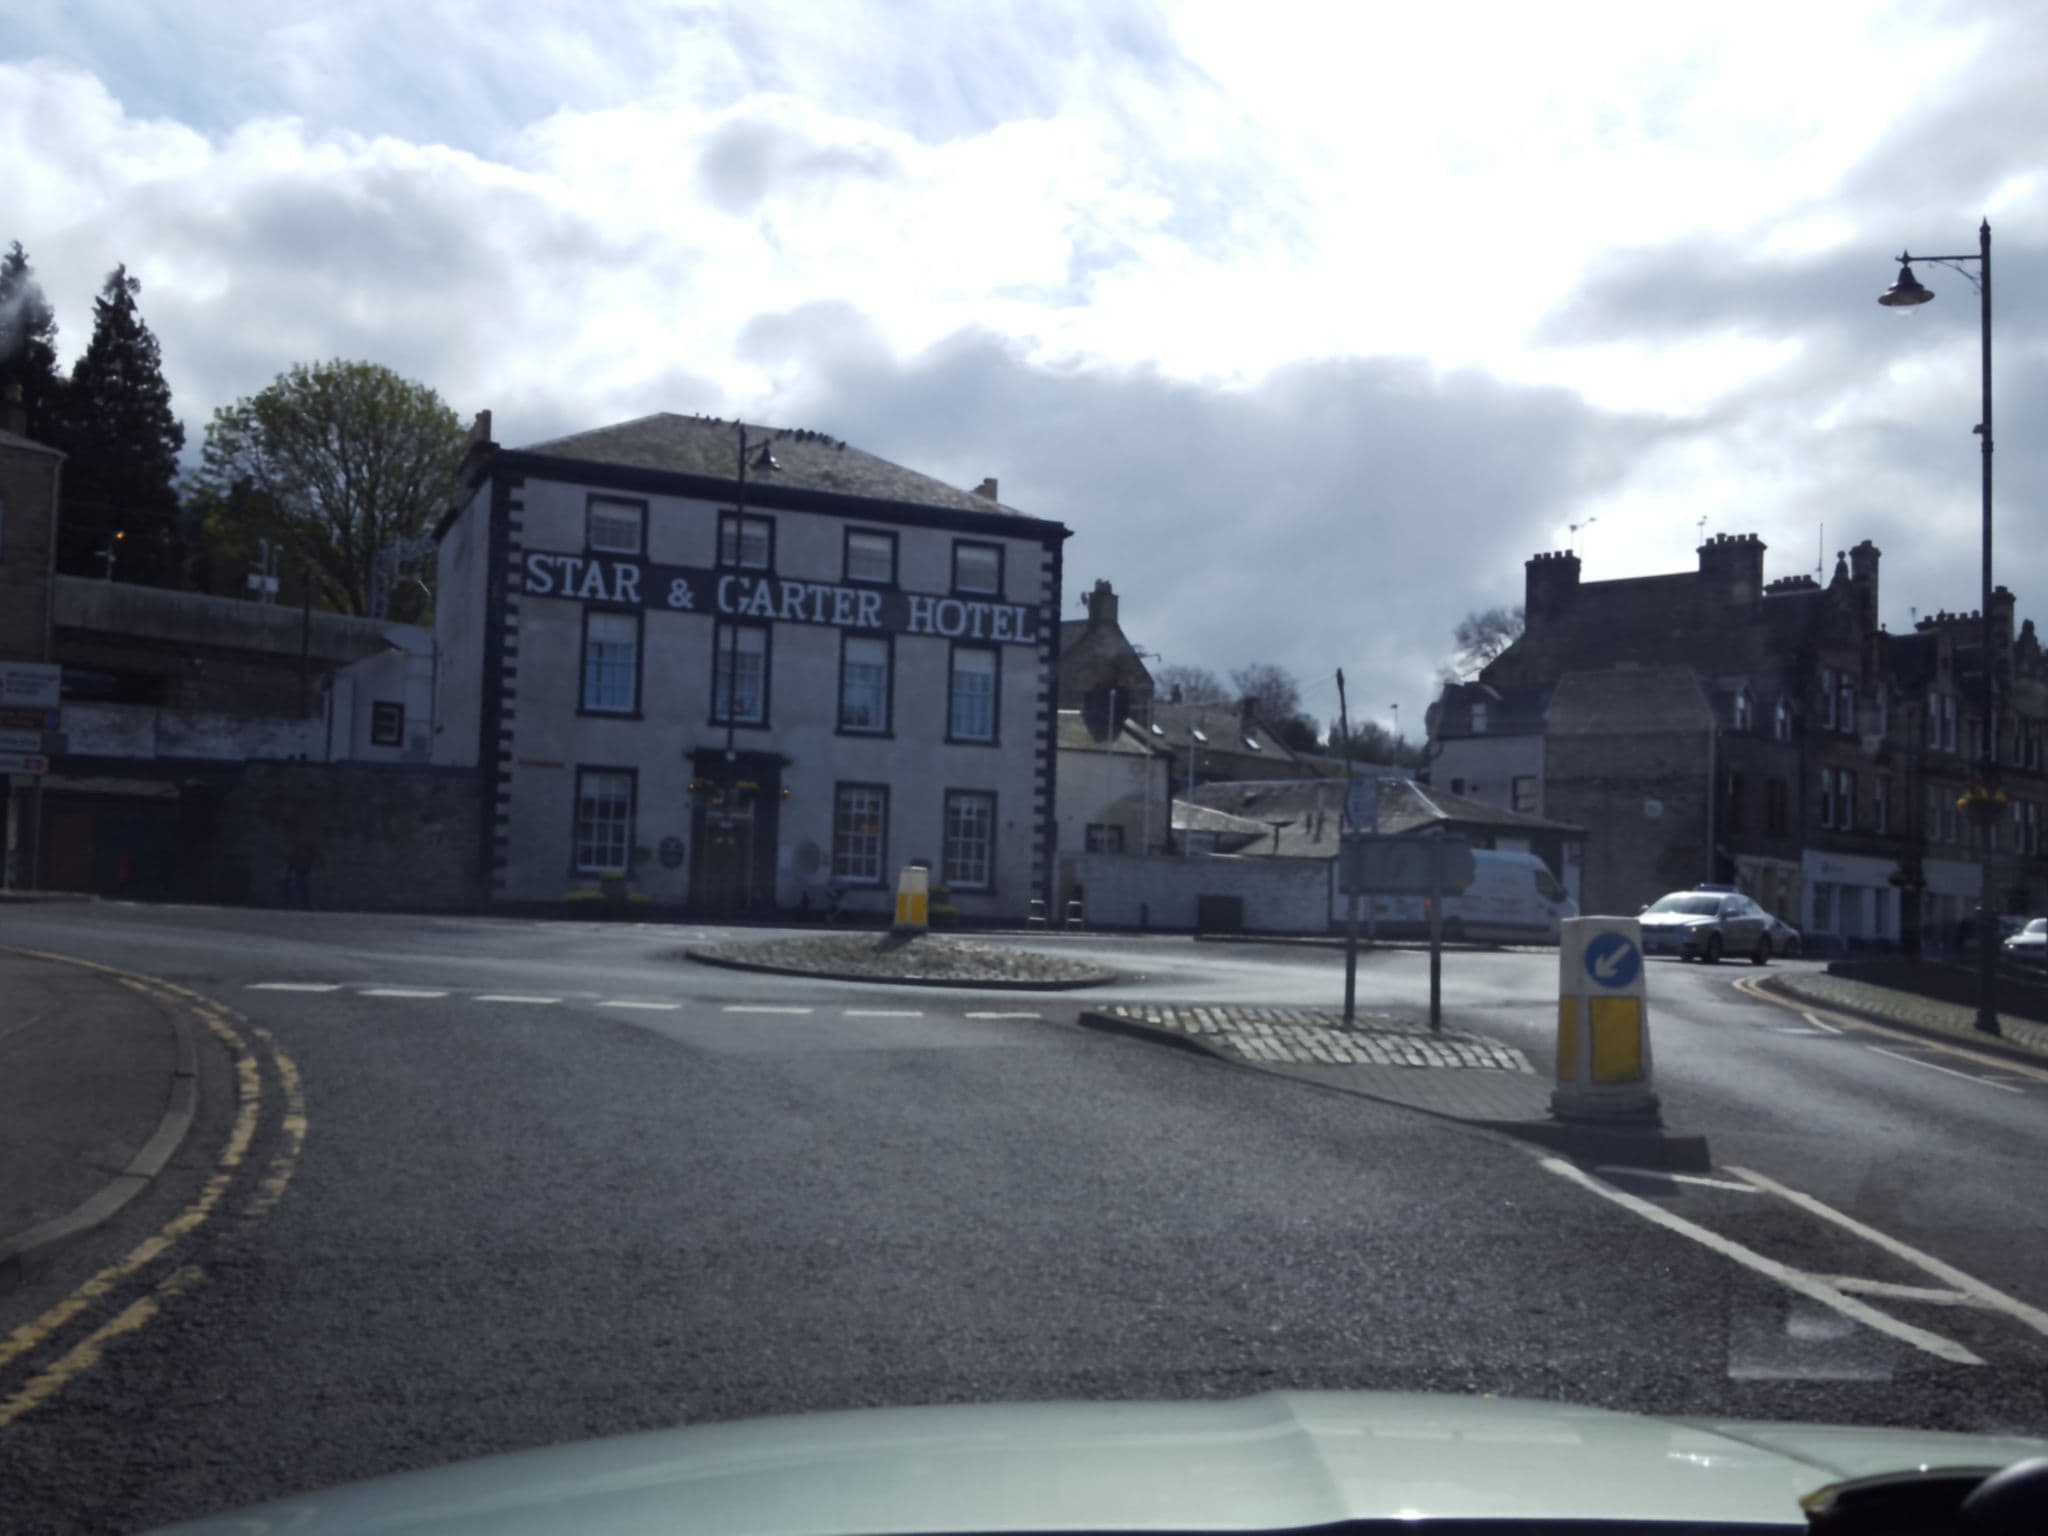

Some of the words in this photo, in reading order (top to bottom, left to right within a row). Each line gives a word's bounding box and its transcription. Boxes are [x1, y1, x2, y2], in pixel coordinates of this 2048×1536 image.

[525, 553, 641, 602] STAR
[667, 579, 694, 609] &
[717, 575, 882, 628] GARTER
[908, 596, 1037, 644] HOTEL
